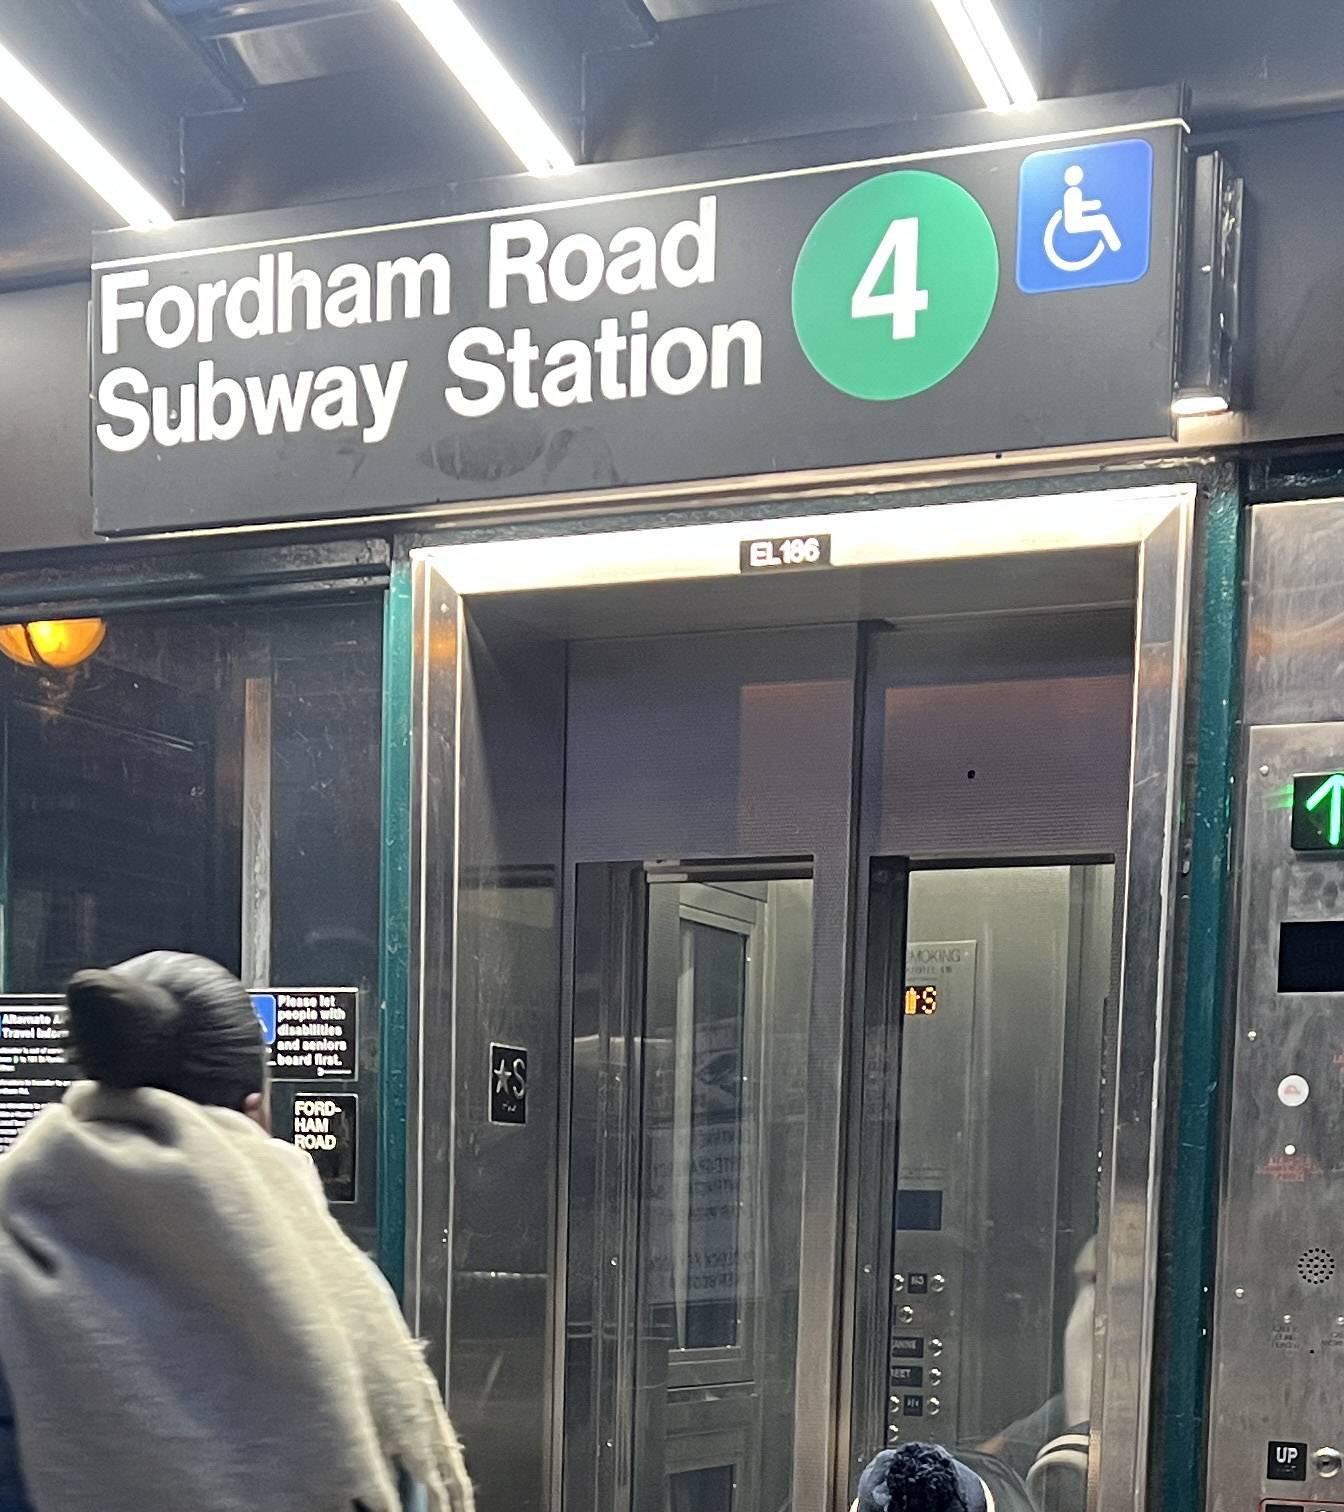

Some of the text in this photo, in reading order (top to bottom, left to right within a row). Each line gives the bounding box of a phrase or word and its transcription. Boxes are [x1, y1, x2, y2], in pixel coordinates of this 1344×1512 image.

[100, 195, 716, 356] Fordham Road
[851, 217, 928, 340] 4
[96, 314, 764, 453] Subway Station
[278, 995, 335, 1007] Please let
[2, 1014, 52, 1024] Alternate
[277, 1008, 345, 1022] people with
[2, 1028, 35, 1039] Travel
[277, 1023, 342, 1036] disabilities
[277, 1039, 347, 1051] and seniors
[277, 1053, 342, 1066] board first.
[295, 1101, 342, 1116] FORD-
[295, 1118, 328, 1132] HAM
[295, 1134, 336, 1150] ROAD
[1276, 1446, 1298, 1464] UP
